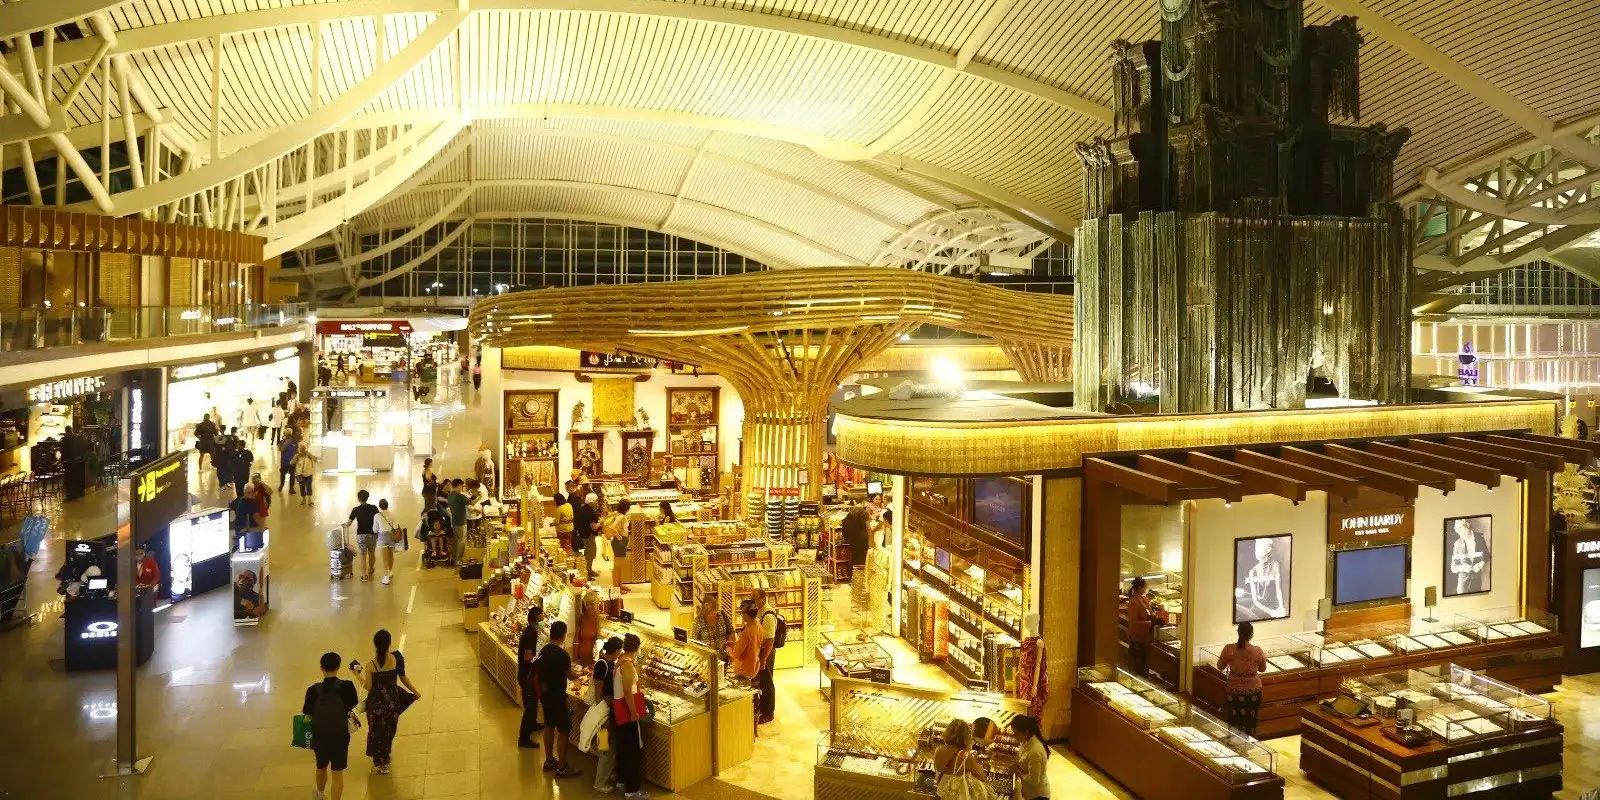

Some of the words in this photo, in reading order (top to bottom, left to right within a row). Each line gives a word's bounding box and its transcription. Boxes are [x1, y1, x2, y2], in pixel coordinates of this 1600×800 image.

[1458, 368, 1478, 376] BALI
[1341, 517, 1368, 531] JOHN
[1369, 514, 1404, 527] HARDY
[81, 630, 118, 639] OAKLE
